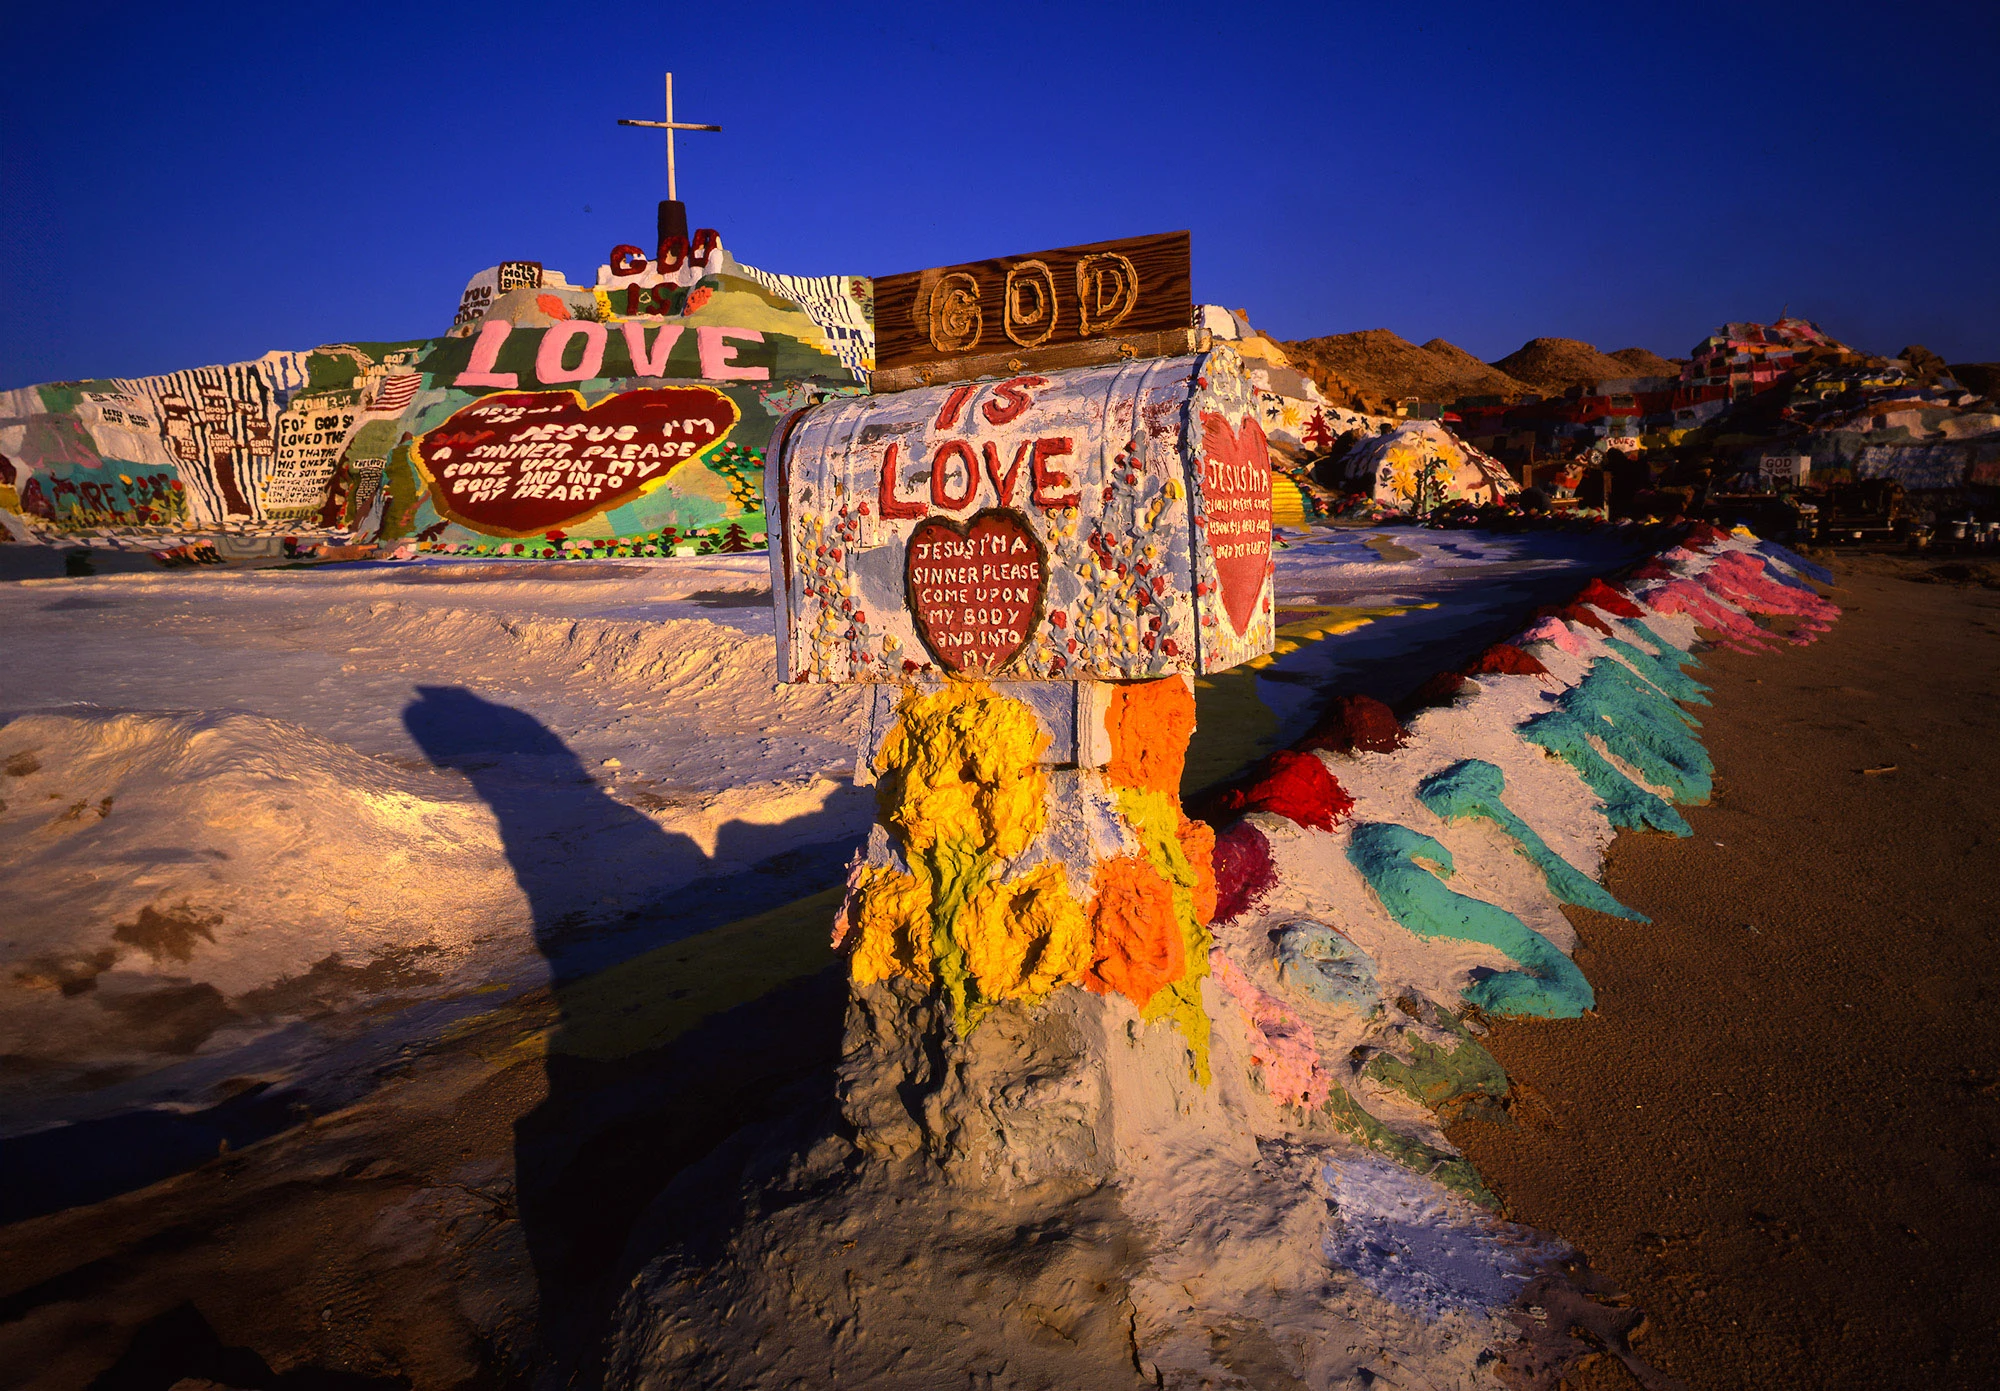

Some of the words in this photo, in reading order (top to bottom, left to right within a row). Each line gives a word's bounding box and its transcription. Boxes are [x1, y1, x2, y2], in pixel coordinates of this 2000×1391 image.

[610, 228, 720, 277] GOD
[504, 269, 536, 281] HOLY
[464, 286, 492, 303] YOU
[627, 282, 679, 316] IS
[929, 251, 1138, 352] GOD
[453, 319, 770, 389] LOVE
[934, 375, 1050, 431] IS
[314, 415, 339, 430] GOD
[510, 423, 639, 442] JESUS
[662, 418, 715, 437] I'M
[281, 433, 322, 447] LOVED
[325, 430, 346, 445] THE
[431, 446, 452, 461] A
[466, 442, 573, 459] SINNER
[581, 441, 696, 460] PLEASE
[278, 460, 296, 470] HIS
[443, 461, 512, 478] COME
[520, 458, 593, 472] UPON
[607, 460, 661, 478] MY
[1766, 458, 1792, 468] GOD
[515, 471, 561, 486] AND
[567, 471, 623, 488] INTO
[879, 436, 1082, 520] LOVE
[469, 488, 507, 503] MY
[511, 484, 602, 501] HEART
[916, 538, 974, 560] JESUS
[978, 533, 1007, 556] I'M
[1011, 536, 1028, 555] A
[912, 565, 978, 584] SINNER
[982, 562, 1039, 583] PLEASE
[921, 588, 968, 604] COME
[976, 587, 1030, 603] UPON
[929, 609, 955, 625] MY
[963, 607, 1020, 625] BODY
[979, 629, 1021, 645] INTO
[962, 649, 996, 673] MY
